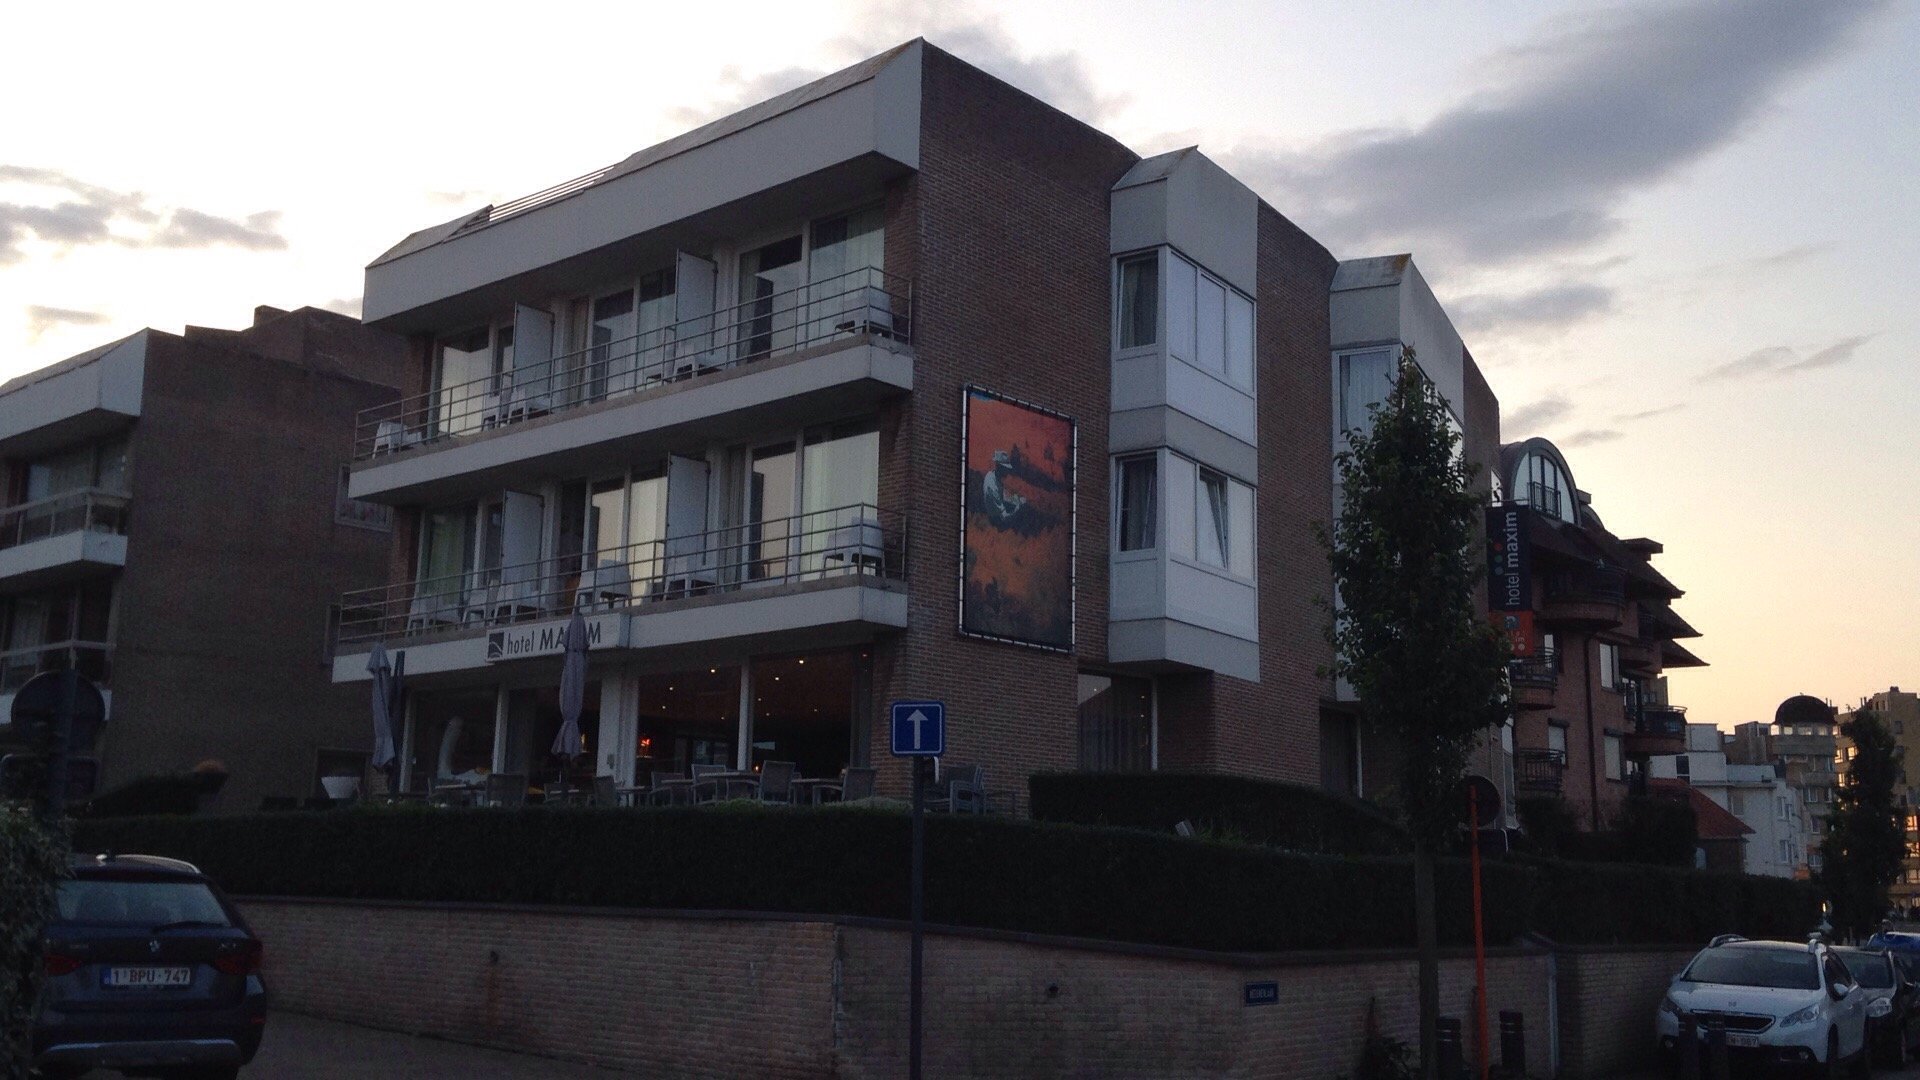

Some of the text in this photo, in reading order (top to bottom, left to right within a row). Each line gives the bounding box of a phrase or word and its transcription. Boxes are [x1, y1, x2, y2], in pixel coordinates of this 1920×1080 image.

[1503, 511, 1520, 606] hotel maxim
[507, 630, 535, 655] hotel
